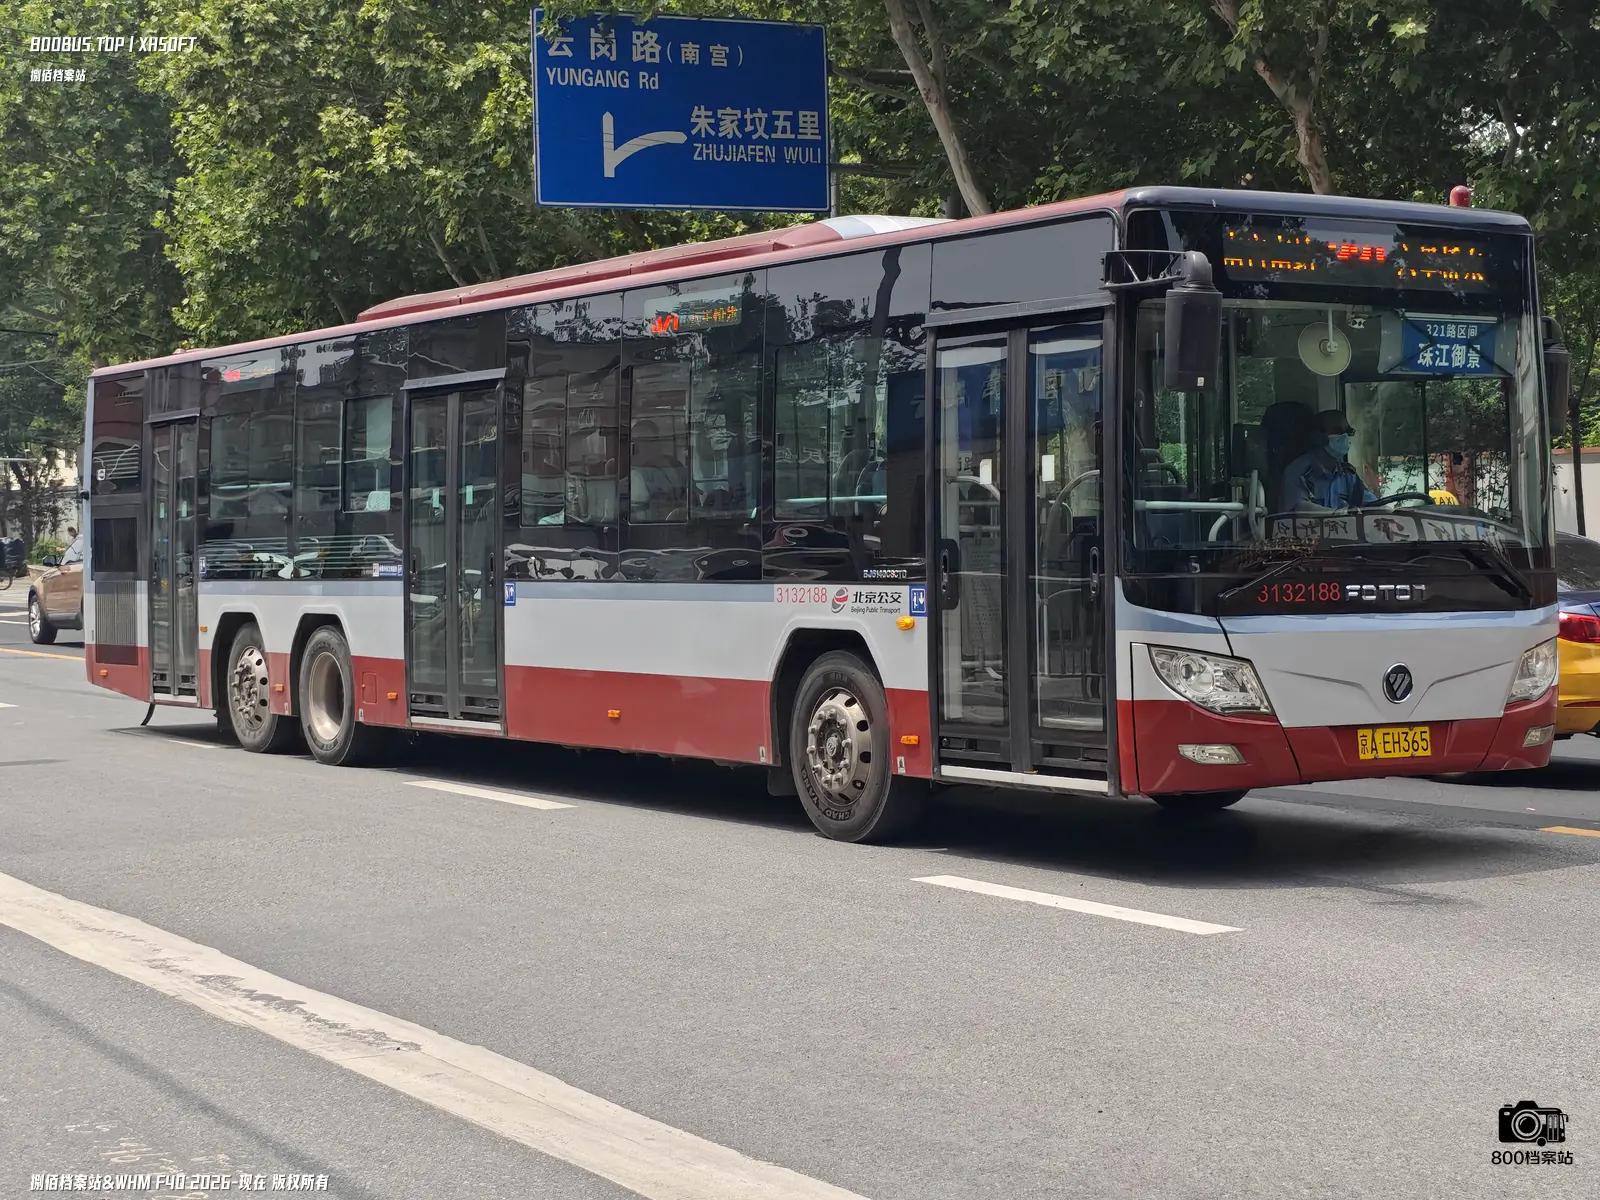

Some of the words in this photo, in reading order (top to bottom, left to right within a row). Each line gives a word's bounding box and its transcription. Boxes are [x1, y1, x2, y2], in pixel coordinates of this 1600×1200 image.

[546, 67, 630, 89] YUNGANG
[639, 71, 659, 90] Rd
[690, 105, 822, 140] 朱家坟五里
[693, 143, 776, 163] ZHUJIAFEN
[784, 146, 821, 164] WULI
[1426, 324, 1478, 339] 321路区间
[776, 587, 828, 603] 3132188
[852, 591, 902, 604] 北京公交
[1257, 582, 1341, 602] 3132188
[1345, 584, 1426, 601] FOTON
[851, 607, 865, 615] Beijing
[879, 607, 901, 615] Transport
